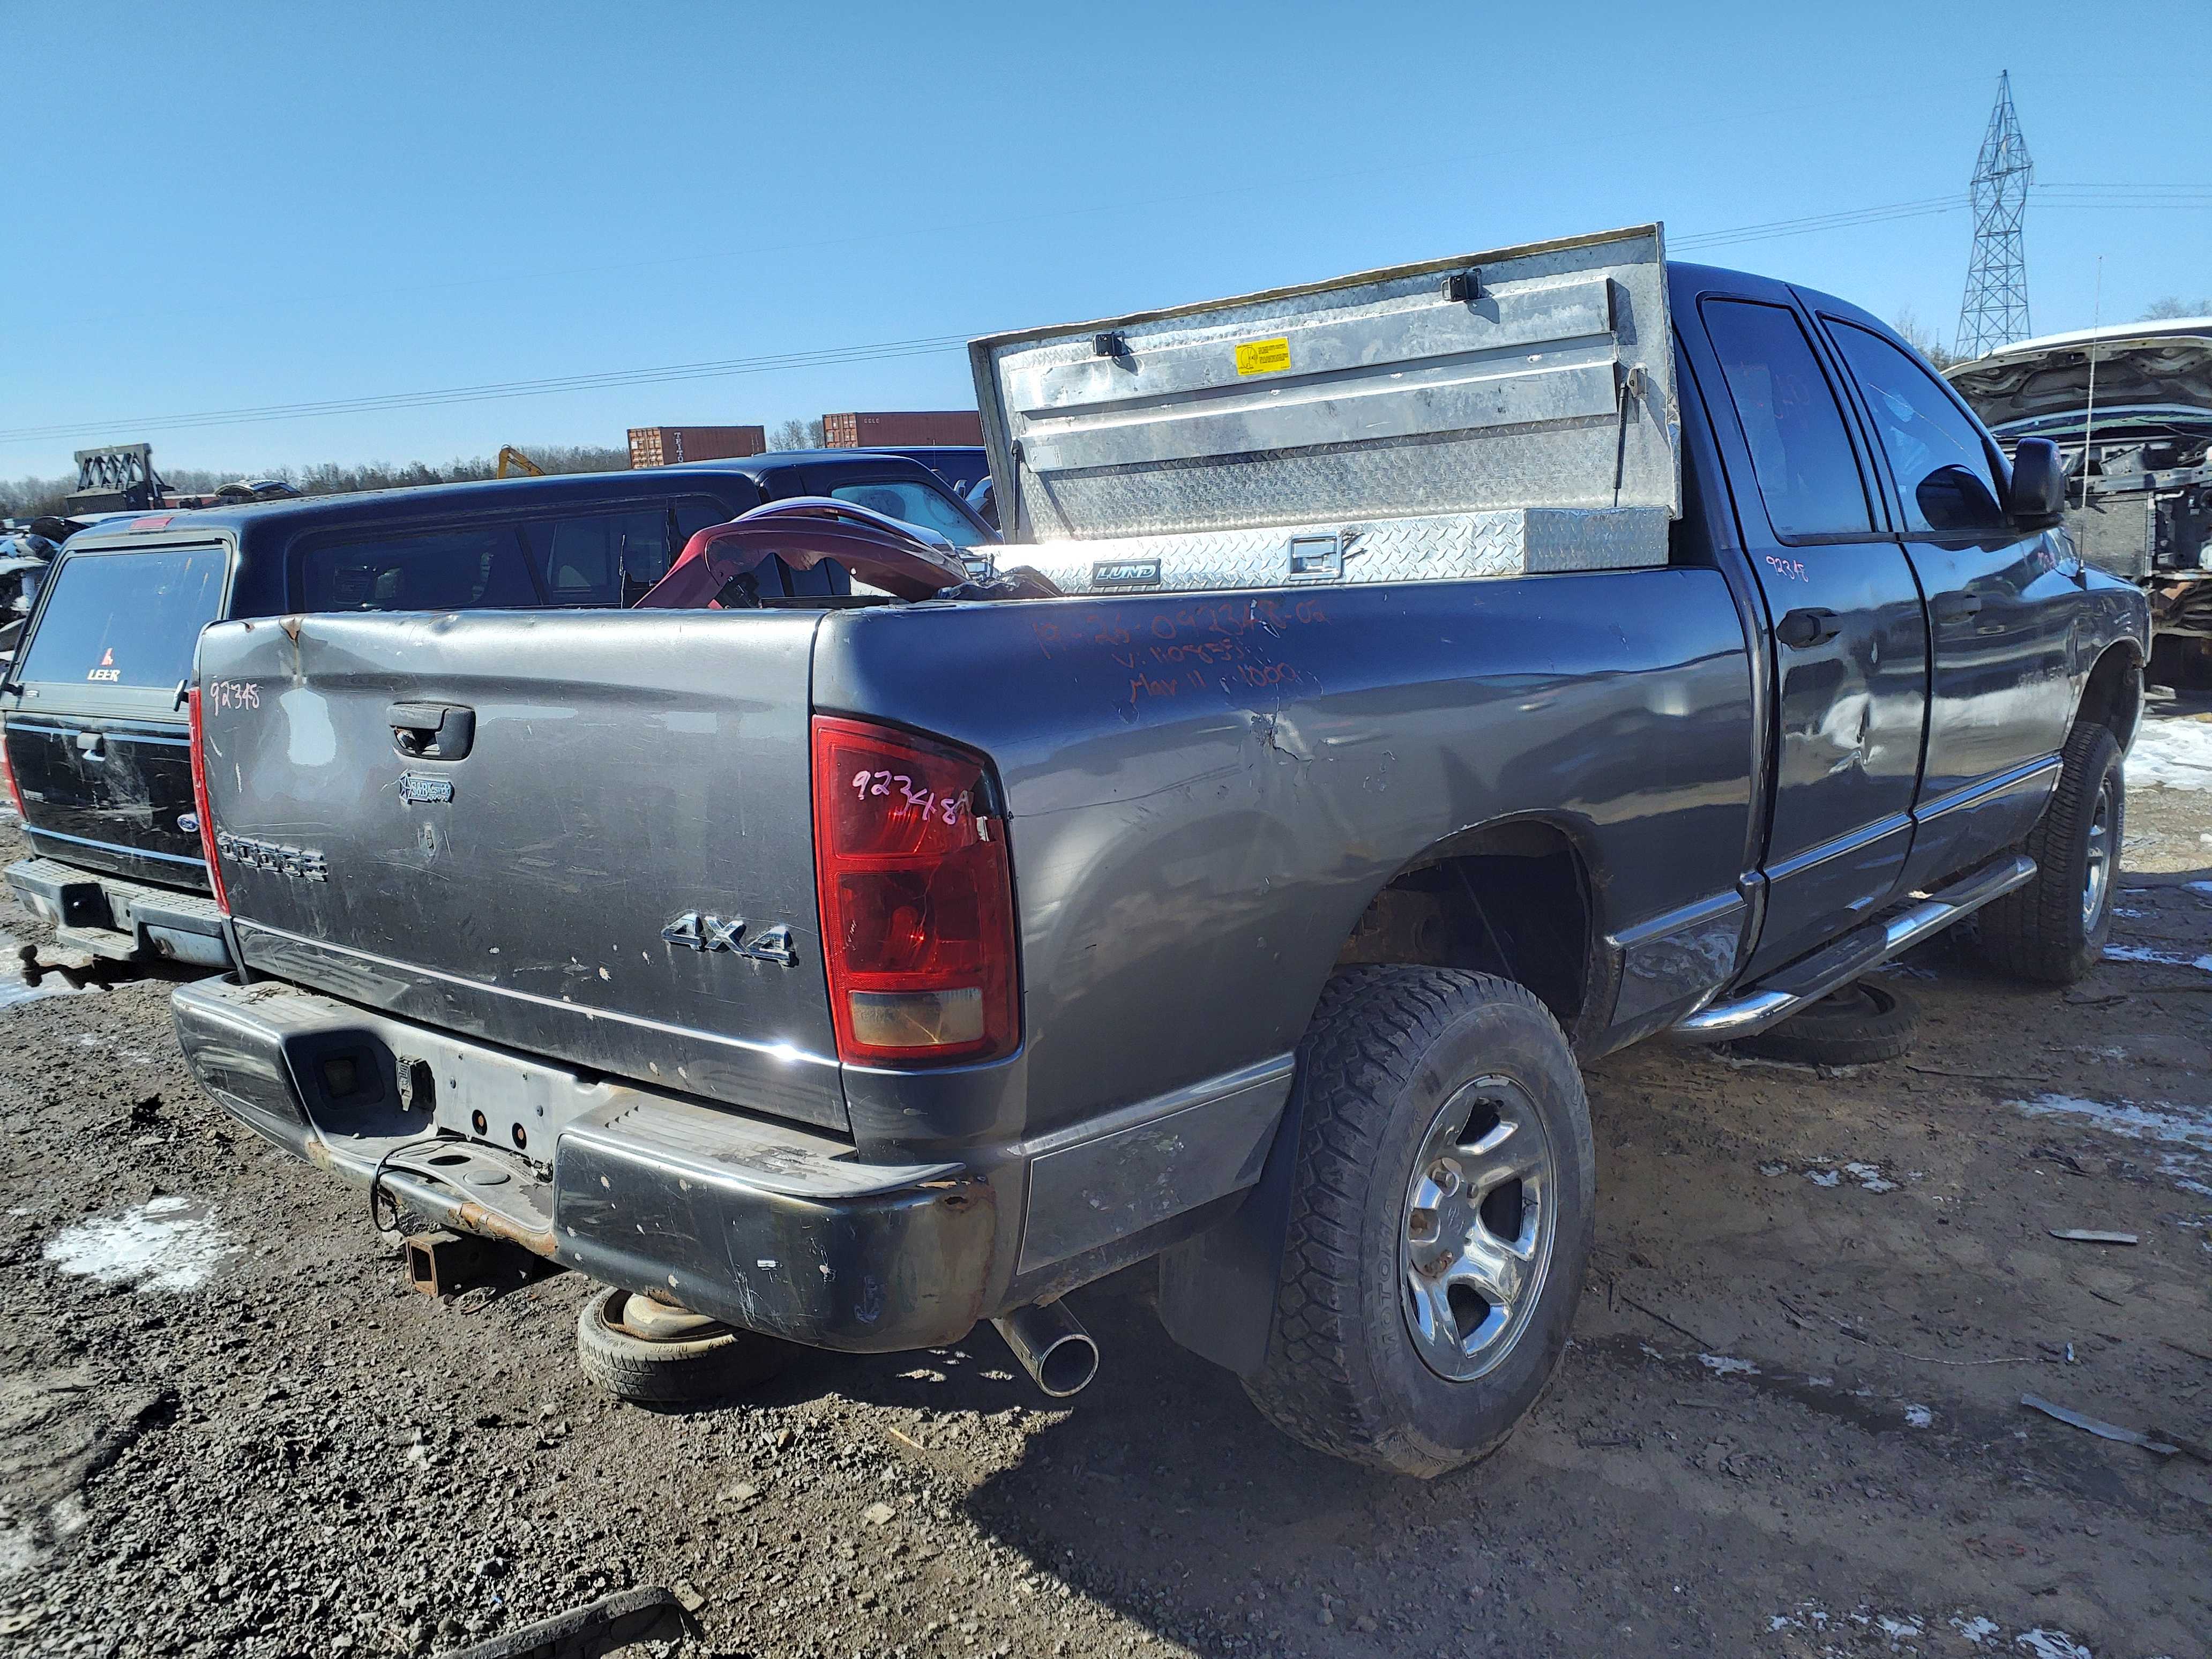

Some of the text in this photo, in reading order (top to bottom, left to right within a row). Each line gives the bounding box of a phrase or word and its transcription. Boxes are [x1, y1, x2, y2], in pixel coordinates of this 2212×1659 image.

[1095, 565, 1156, 580] LUND
[87, 669, 121, 682] LEER
[210, 681, 260, 716] 92348
[852, 769, 961, 825] 92348
